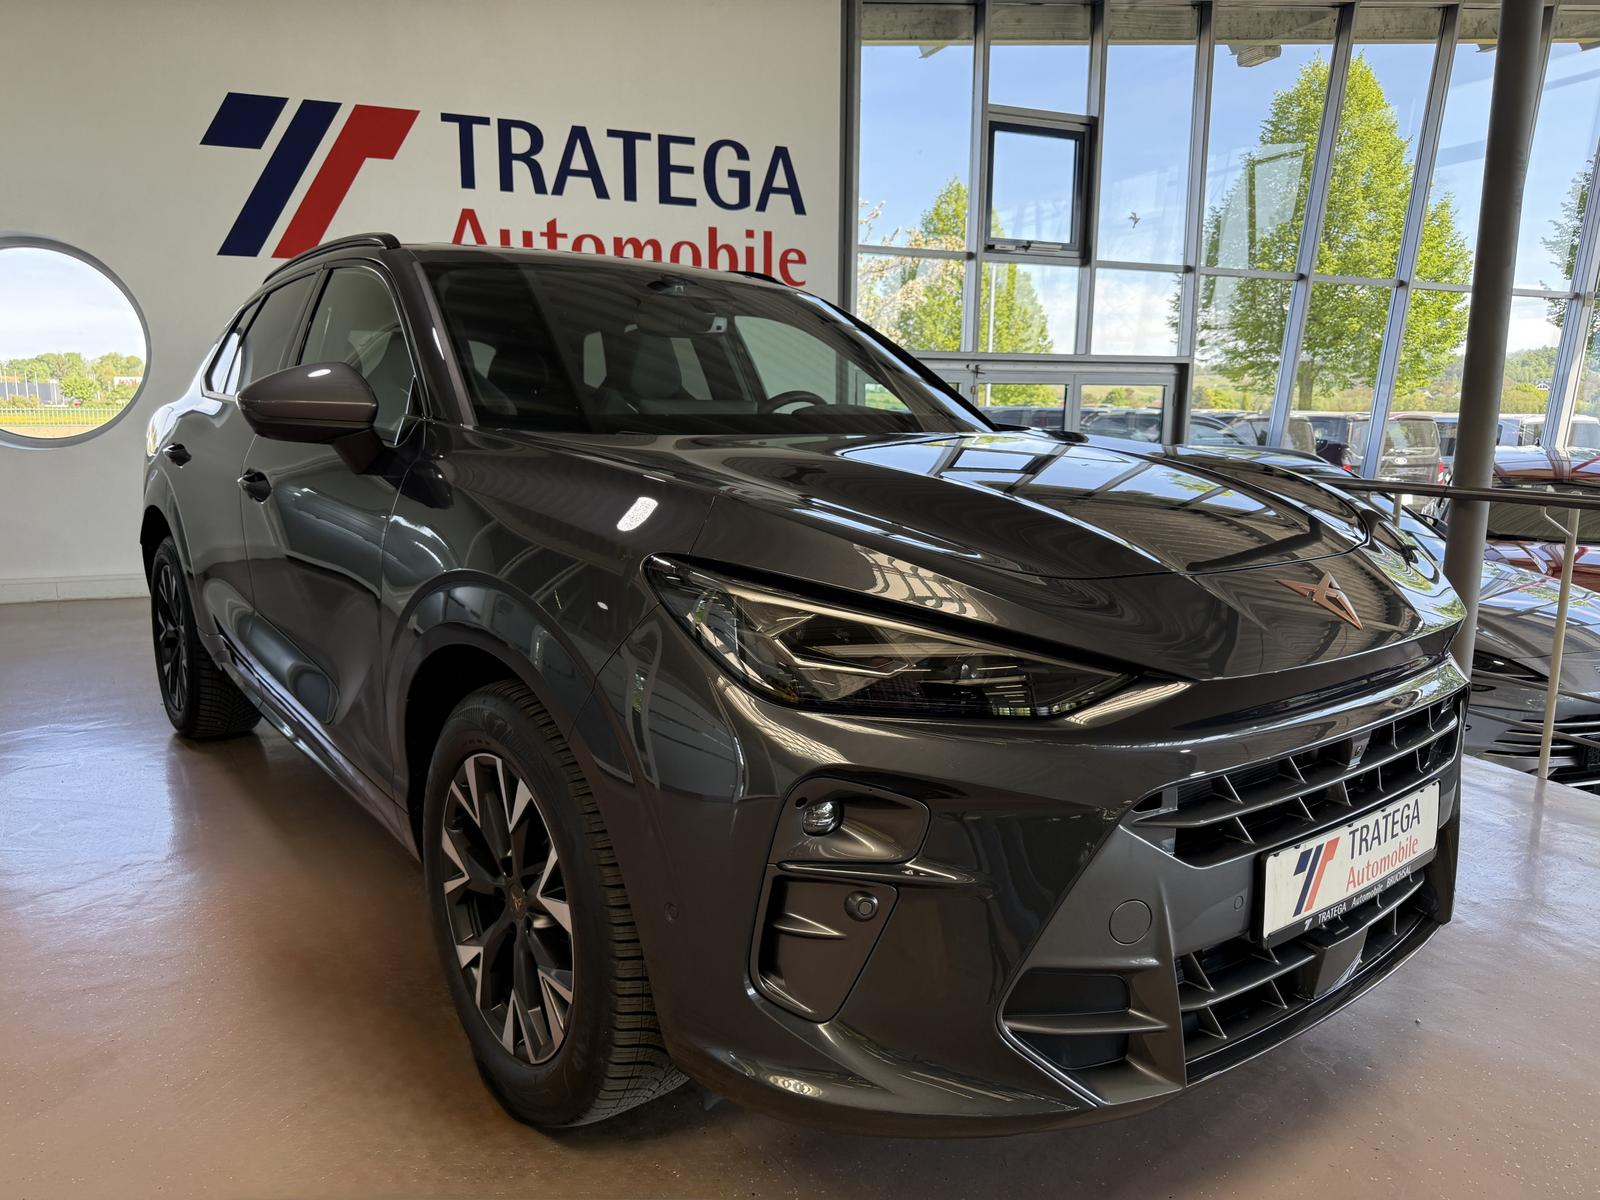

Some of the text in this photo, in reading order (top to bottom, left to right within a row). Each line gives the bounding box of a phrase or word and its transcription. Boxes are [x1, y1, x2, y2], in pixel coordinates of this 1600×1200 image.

[440, 112, 807, 216] TRATEGA
[1348, 798, 1421, 860] TRATEGA
[1345, 834, 1419, 893] Automobile
[1318, 902, 1347, 924] TRATEGA
